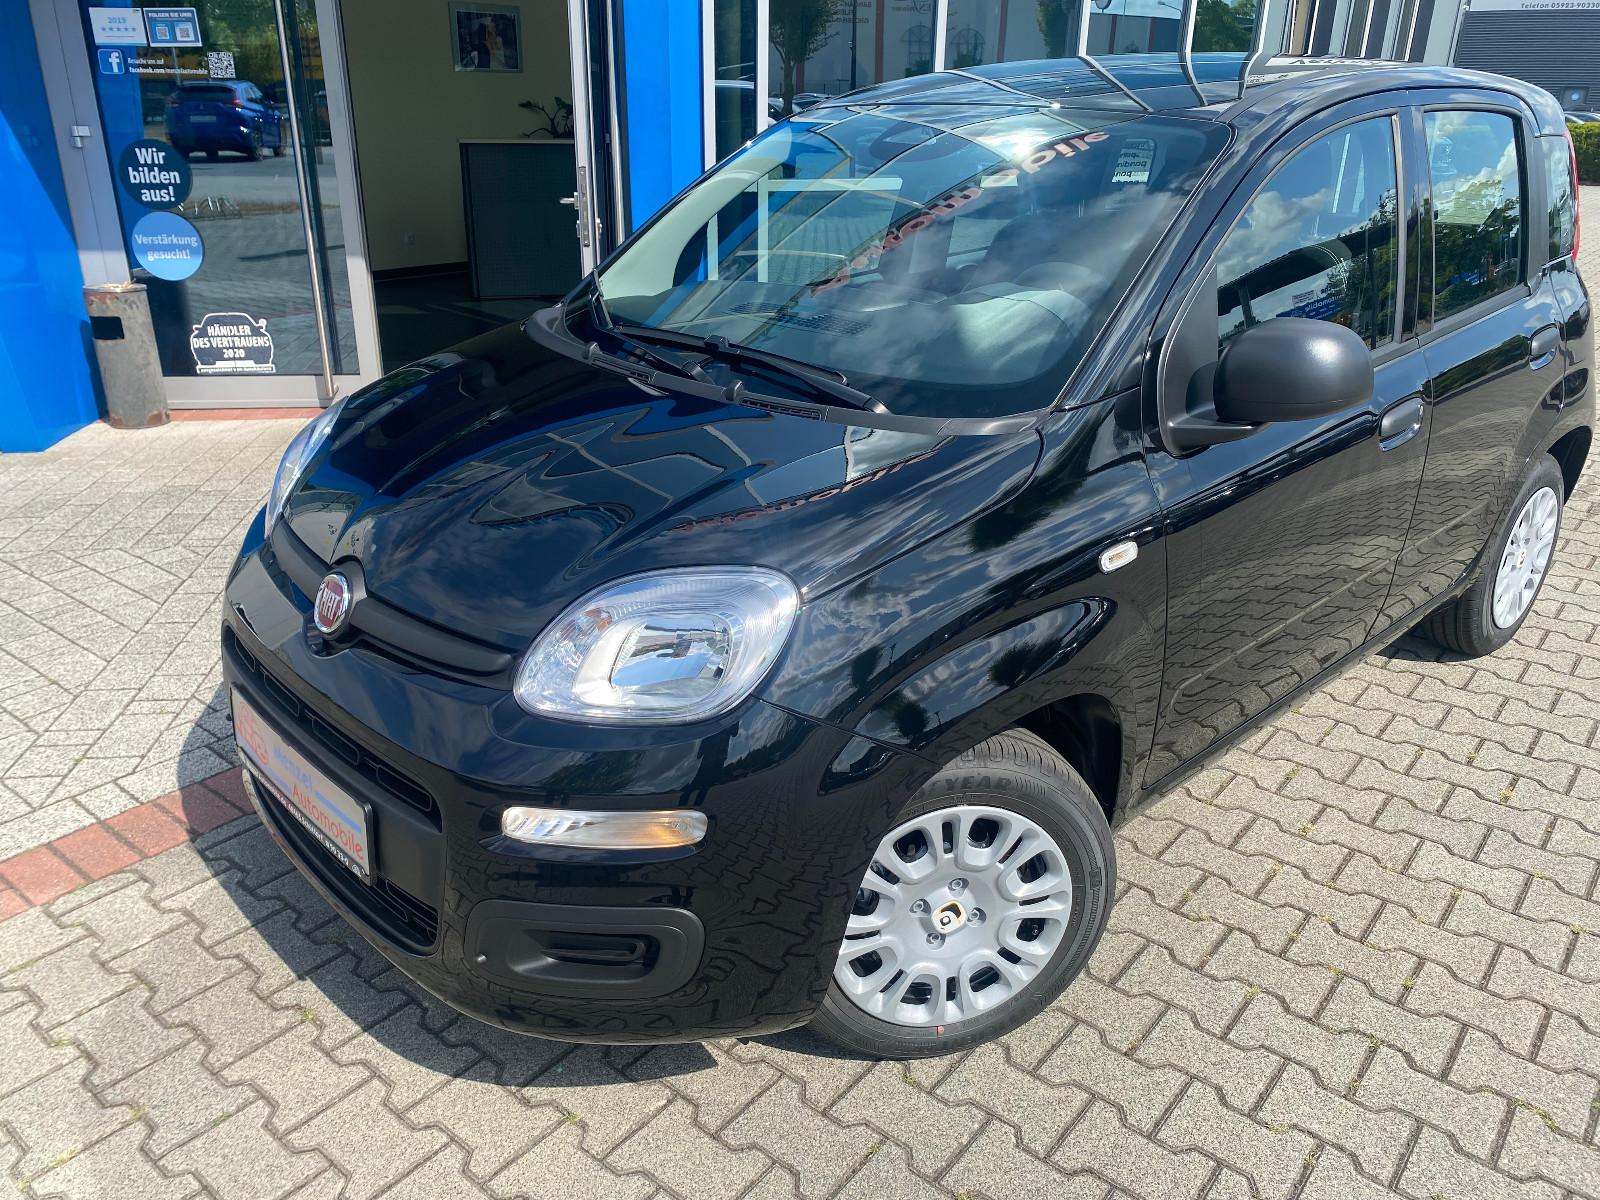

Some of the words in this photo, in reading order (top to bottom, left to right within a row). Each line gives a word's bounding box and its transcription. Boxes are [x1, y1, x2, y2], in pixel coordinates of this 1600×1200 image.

[135, 147, 166, 165] Wir
[128, 166, 181, 185] bilden
[141, 186, 175, 202] aus!
[134, 233, 198, 248] Verstärkung
[147, 248, 191, 261] gesucht!
[207, 323, 252, 336] HÄNDLER
[192, 337, 211, 349] DES
[211, 335, 270, 349] VERTRAUENS
[223, 347, 245, 358] 2020
[319, 587, 342, 620] FIAT
[291, 782, 366, 860] Automobile
